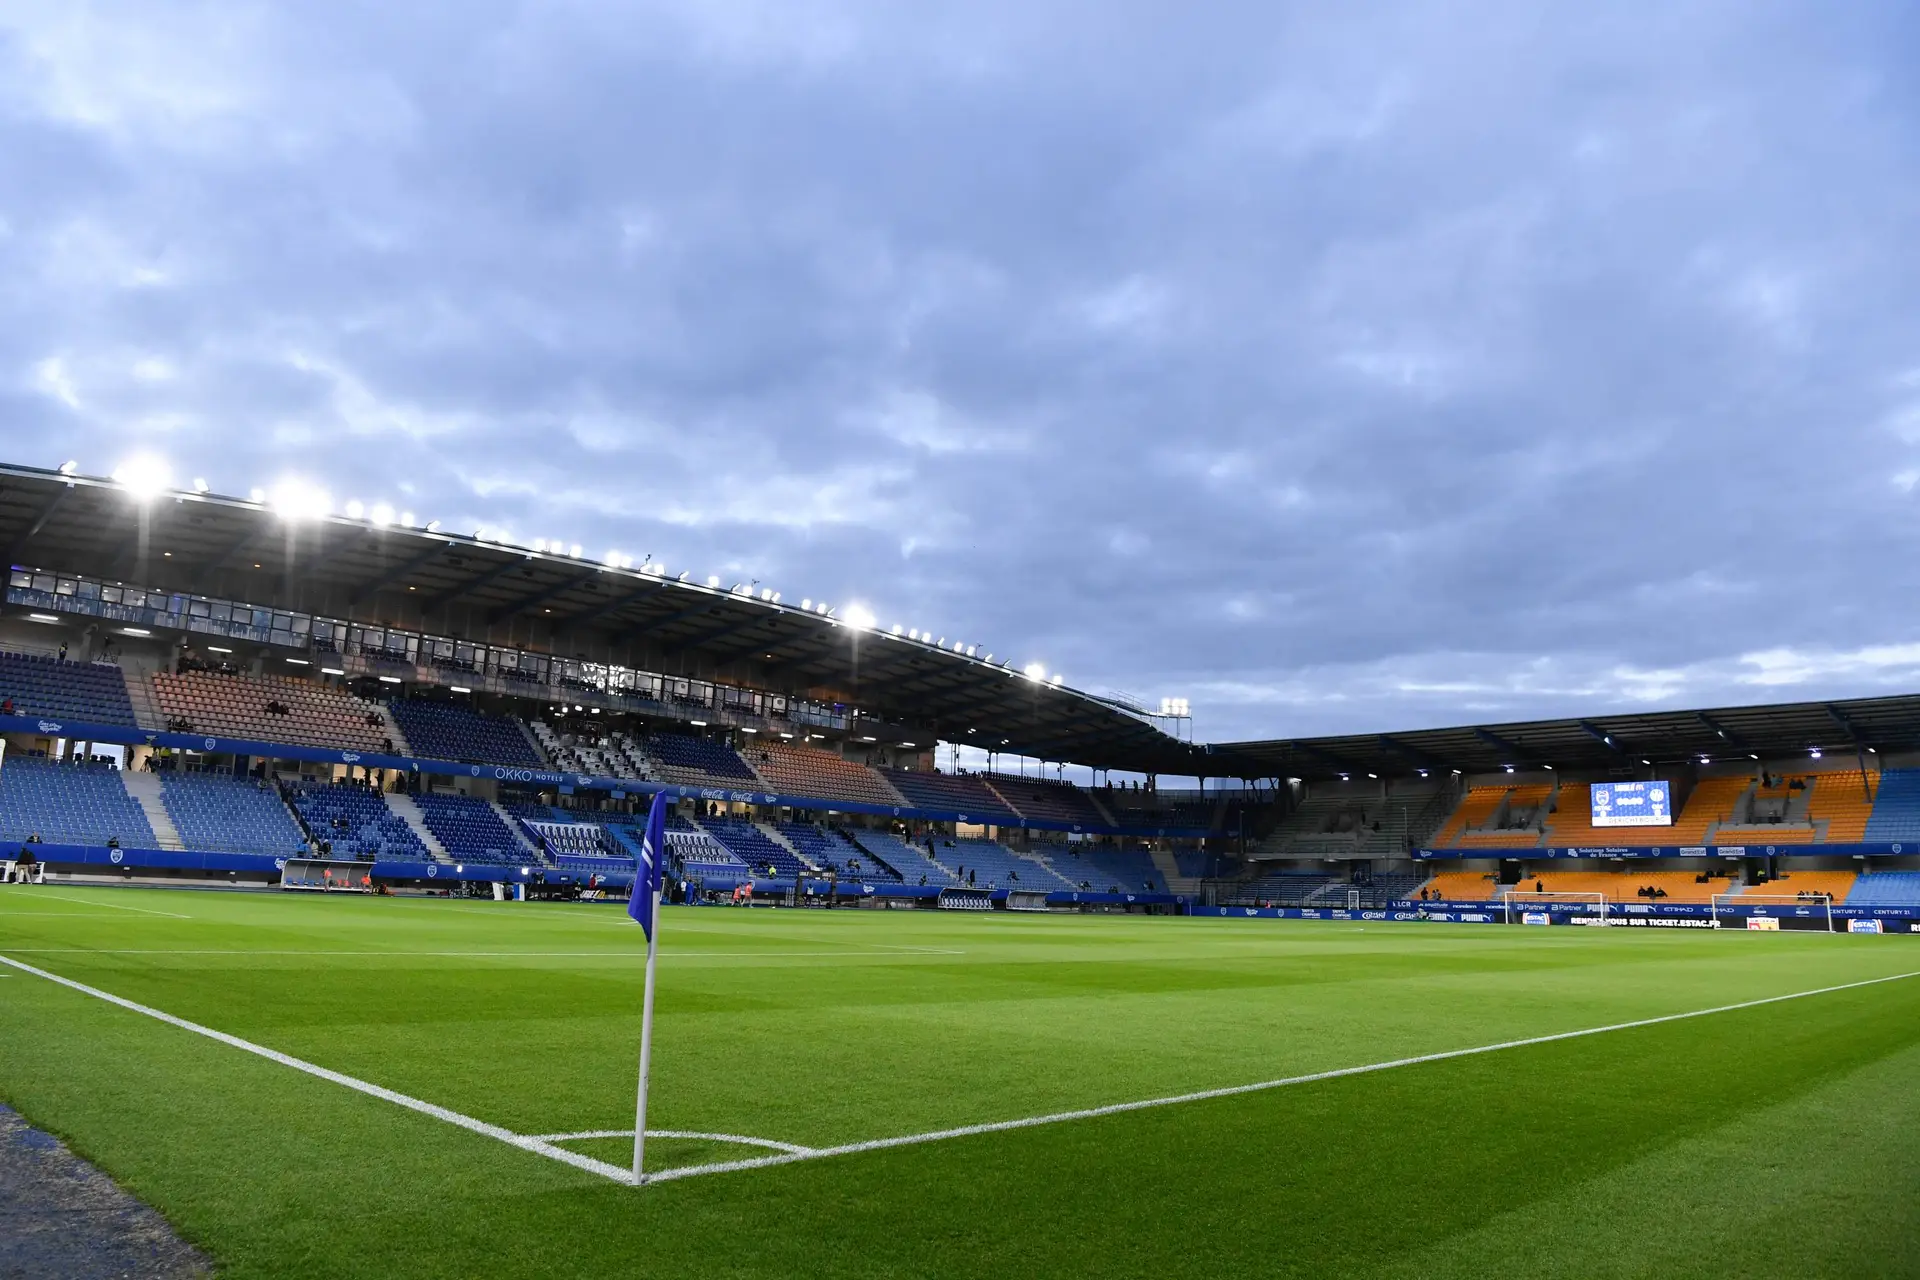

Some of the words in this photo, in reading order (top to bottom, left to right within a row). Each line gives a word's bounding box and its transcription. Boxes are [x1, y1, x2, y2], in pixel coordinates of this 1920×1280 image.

[495, 767, 532, 782] OKKO
[535, 773, 563, 782] HOTELS
[1624, 905, 1649, 913] PUMA
[1461, 913, 1484, 921] PUMA
[1628, 918, 1647, 926] SUR
[1648, 918, 1721, 928] TICKET.ESTAC.FR
